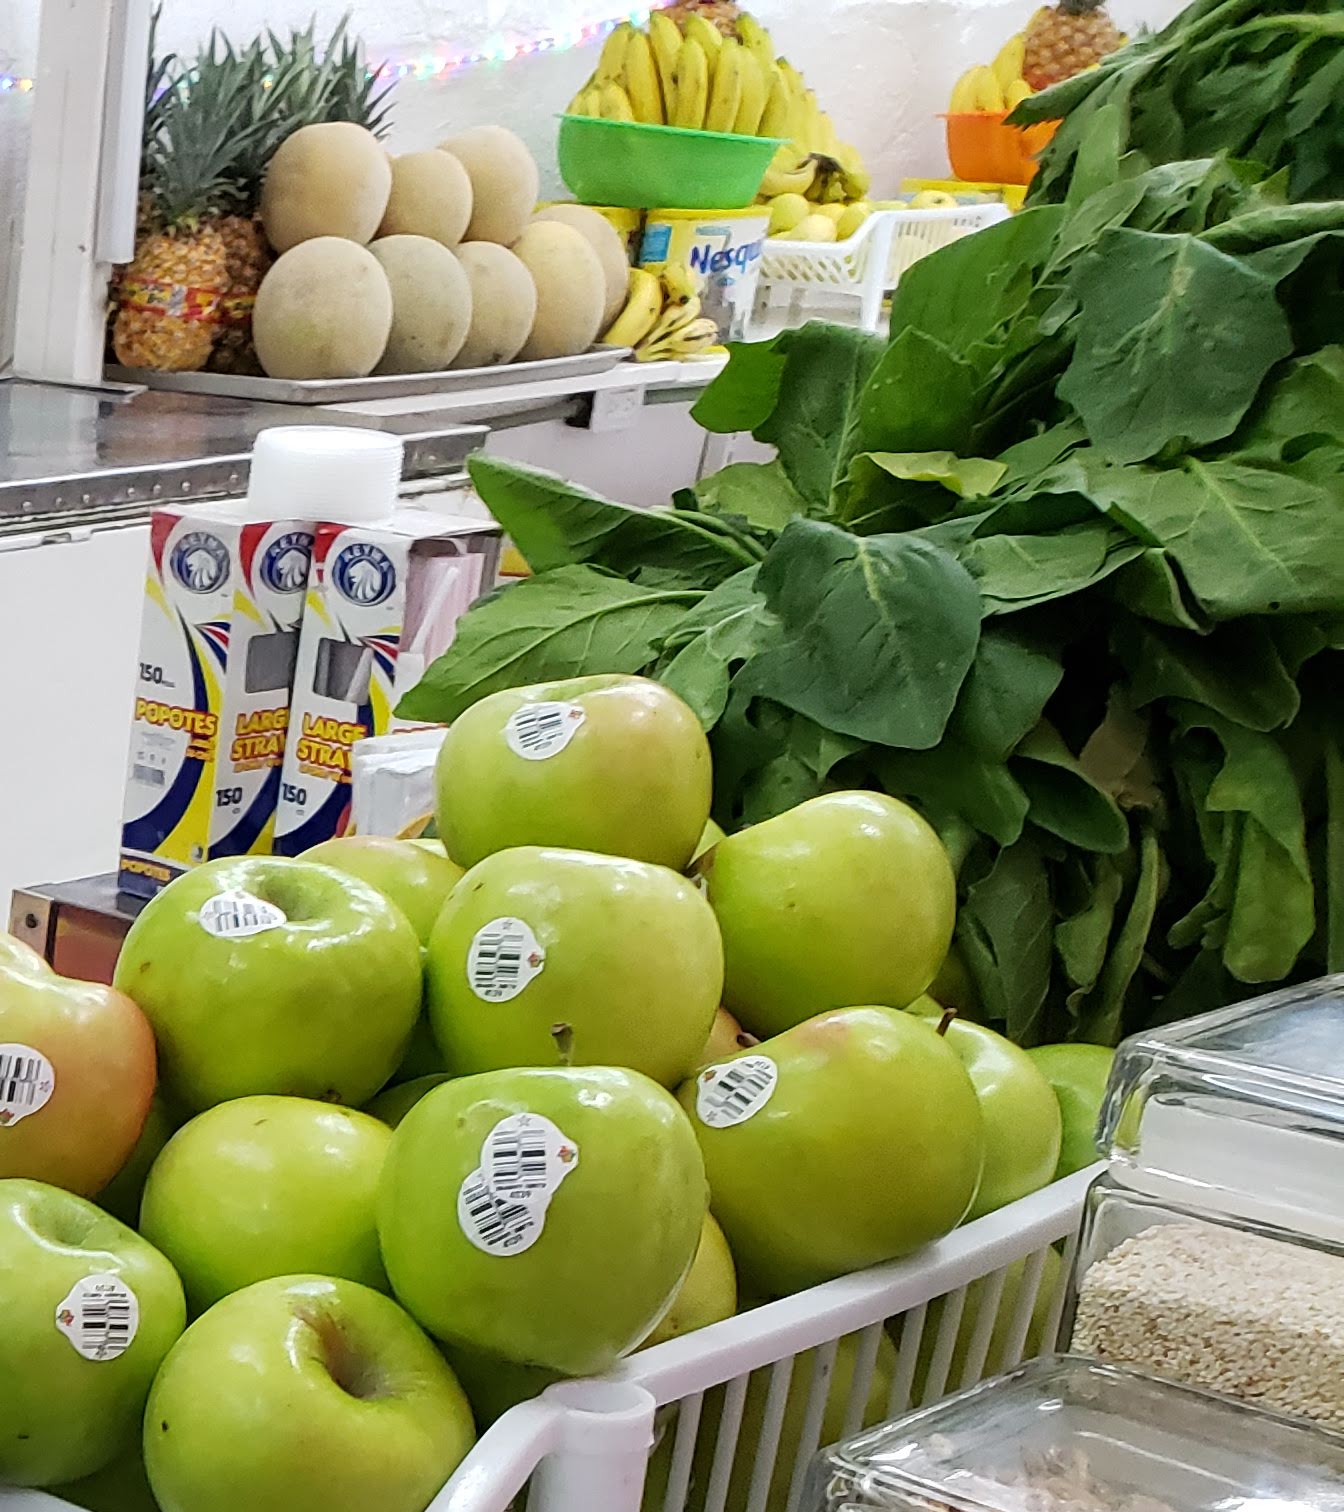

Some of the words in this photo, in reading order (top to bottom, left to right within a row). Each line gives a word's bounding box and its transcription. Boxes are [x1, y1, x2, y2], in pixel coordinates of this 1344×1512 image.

[139, 662, 163, 685] 150
[135, 697, 219, 738] POPOTES
[235, 706, 289, 737] LARG
[302, 711, 368, 746] LARGE
[230, 733, 286, 762] STRA
[296, 737, 353, 776] STRA
[216, 786, 243, 808] 150
[282, 782, 308, 806] 150
